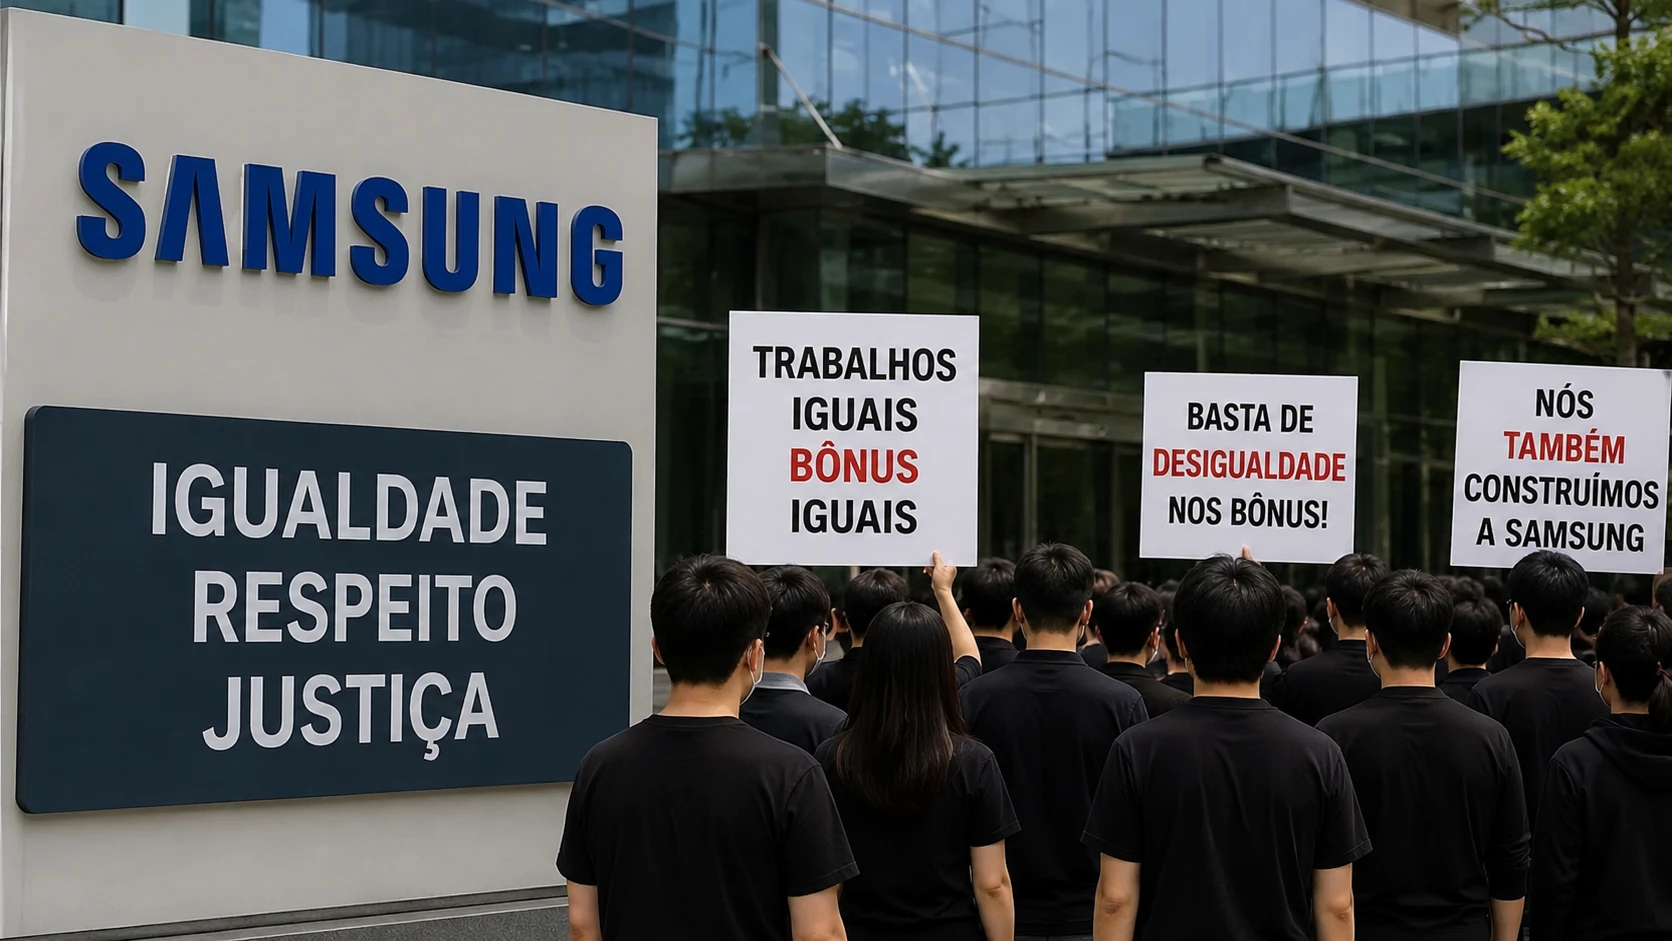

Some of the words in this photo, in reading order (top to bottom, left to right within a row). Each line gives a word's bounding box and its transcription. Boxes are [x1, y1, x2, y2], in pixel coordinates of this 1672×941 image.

[78, 142, 623, 306] SAMSUNG
[753, 346, 956, 381] TRABALHOS
[793, 397, 917, 432] IGUAIS
[1188, 402, 1271, 432] BASTA
[1281, 404, 1313, 433] DE
[1536, 383, 1594, 419] NÓS
[791, 440, 918, 484] BÔNUS
[1504, 428, 1625, 464] TAMBÉM
[1154, 449, 1345, 482] DESIGUALDADE
[152, 462, 547, 546] IGUALDADE
[1464, 472, 1659, 509] CONSTRUÍMOS
[791, 499, 917, 534] IGUAIS
[1169, 496, 1221, 525] NOS
[1231, 492, 1328, 528] BÔNUS!
[1476, 518, 1495, 545] A
[1505, 518, 1644, 552] SAMSUNG
[193, 570, 517, 643] RESPEITO
[203, 671, 499, 760] JUSTIÇA
